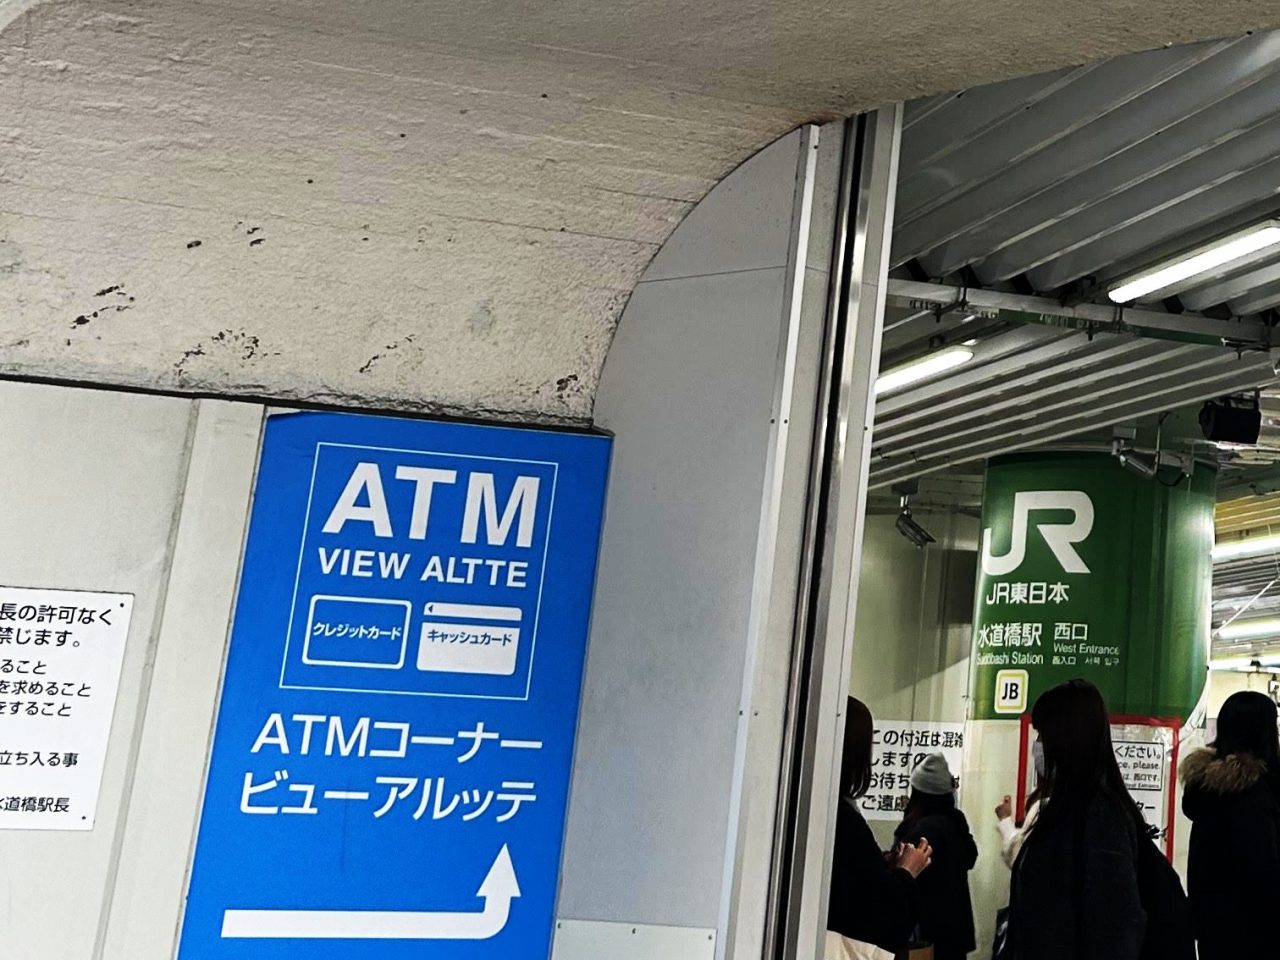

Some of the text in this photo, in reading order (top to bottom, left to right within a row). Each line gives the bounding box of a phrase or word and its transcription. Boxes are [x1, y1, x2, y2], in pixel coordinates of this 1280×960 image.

[321, 462, 541, 548] ATM
[982, 490, 1095, 576] JR
[318, 547, 529, 588] VIEW ALTTE
[986, 582, 1070, 605] JR東日本
[313, 622, 401, 641] クレジットカード
[427, 630, 513, 647] キャッシュカード
[978, 622, 1088, 648] 水道橋駅 西口
[1011, 651, 1044, 665] Station
[1053, 642, 1120, 656] West Entrance
[0, 659, 47, 675] ること
[1002, 682, 1019, 700] JB
[250, 713, 543, 764] ATMコーナー
[0, 750, 79, 768] 立ち入る事
[240, 770, 537, 823] ビューアルッテ
